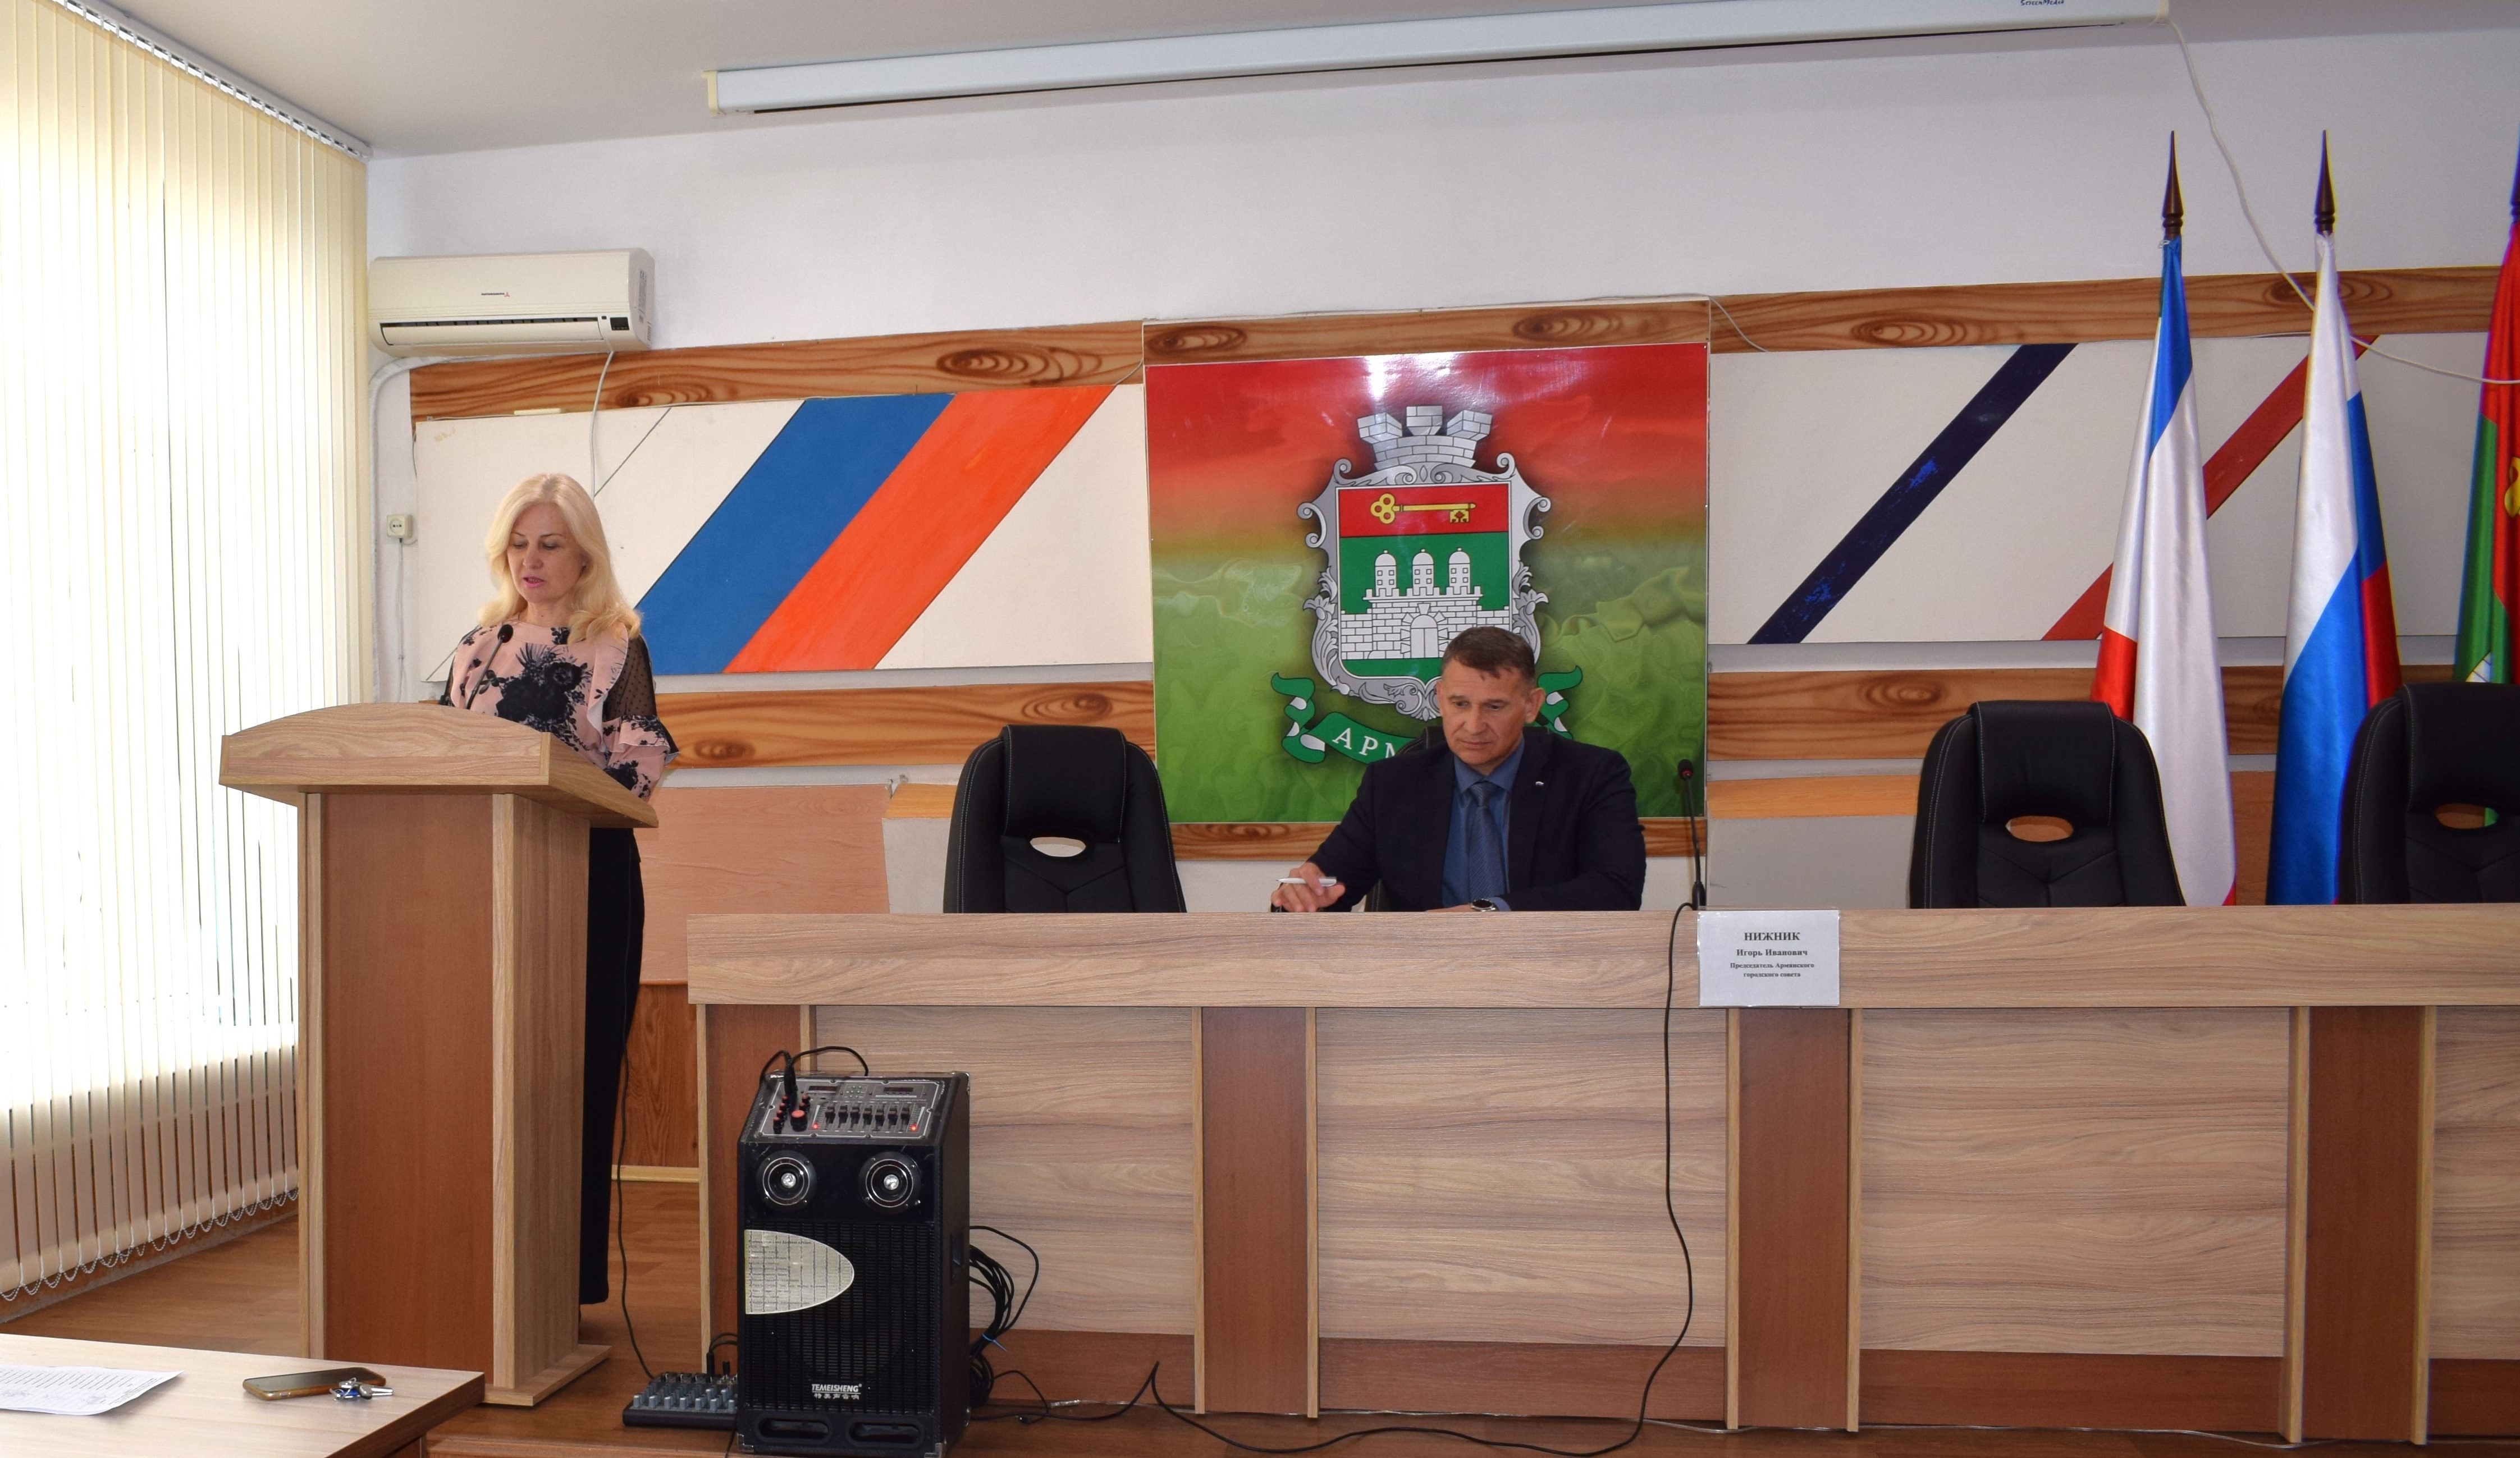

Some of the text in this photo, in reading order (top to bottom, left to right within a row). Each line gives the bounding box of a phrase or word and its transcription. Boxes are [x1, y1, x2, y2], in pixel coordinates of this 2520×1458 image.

[1744, 932, 1800, 941] НИЖНИК
[1736, 949, 1763, 957] Игорь
[812, 1384, 859, 1392] TEMEISHENG
